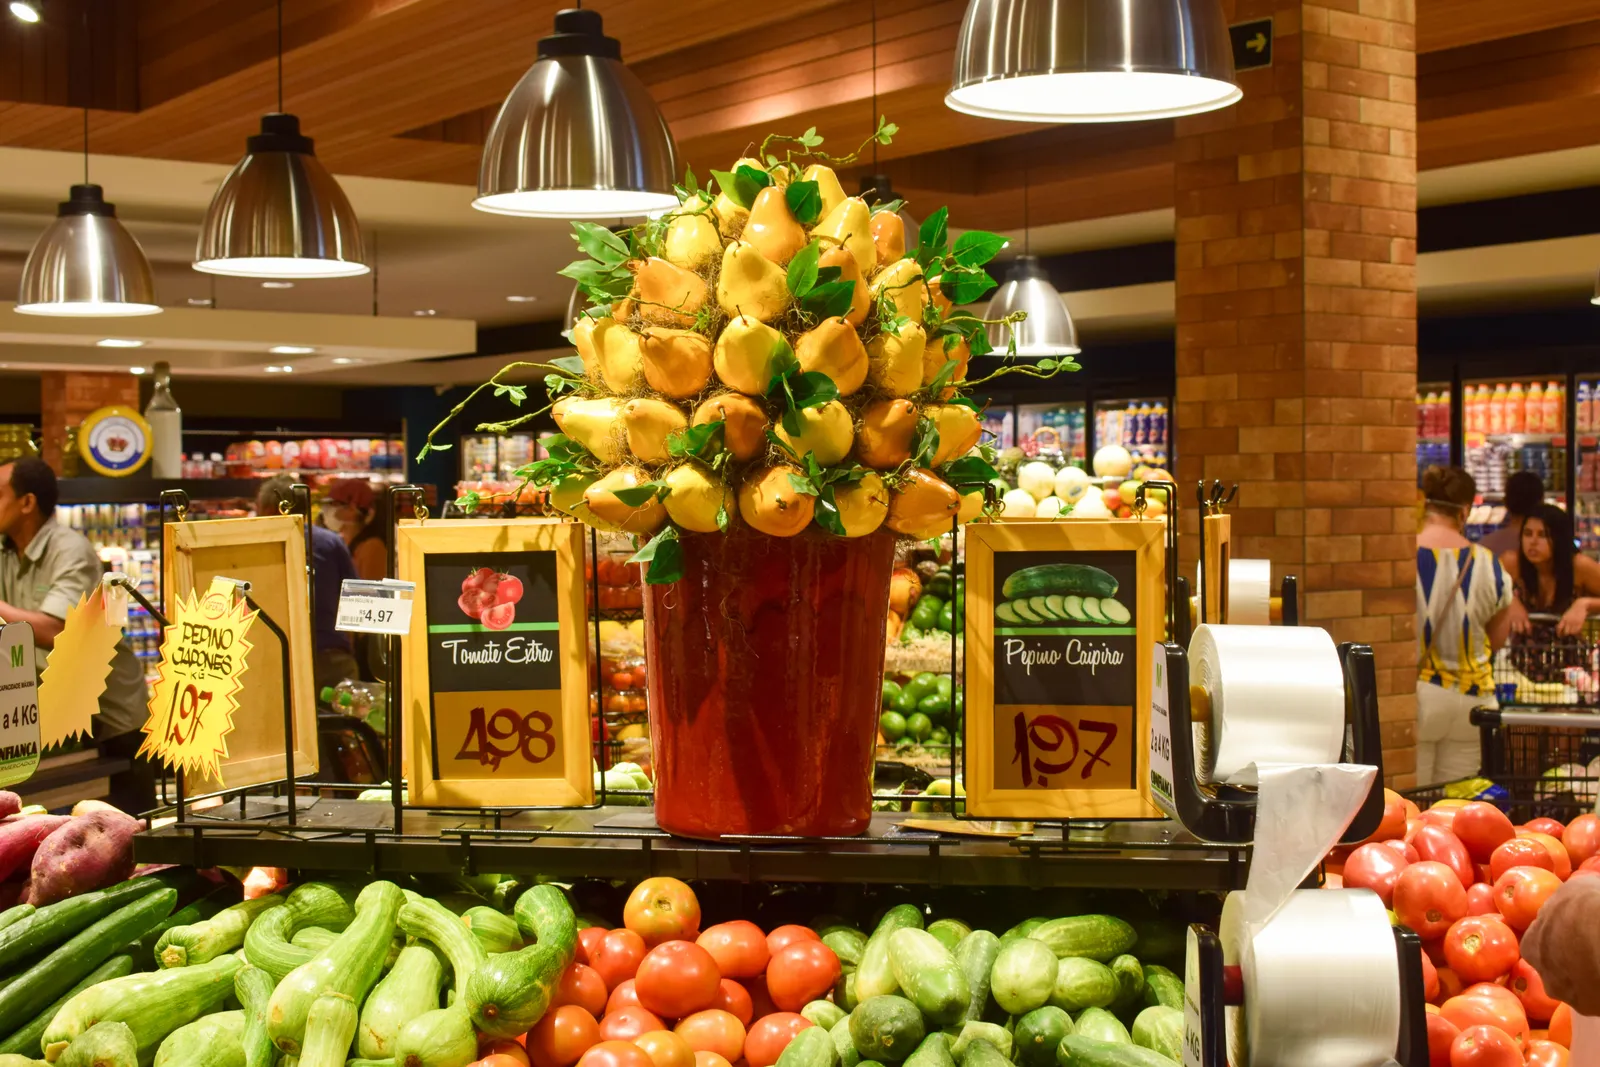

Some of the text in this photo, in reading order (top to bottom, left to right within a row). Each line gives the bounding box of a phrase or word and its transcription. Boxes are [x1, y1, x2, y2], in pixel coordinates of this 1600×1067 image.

[365, 609, 394, 624] 4,97
[182, 621, 234, 650] PEPINO
[11, 644, 24, 668] M
[441, 636, 553, 666] Tomate Extra
[1003, 638, 1124, 676] Pepino Caipira
[1155, 663, 1162, 688] M
[3, 703, 38, 729] a 4 KG
[454, 704, 556, 773] 4,98
[1158, 733, 1161, 756] 4
[1162, 735, 1170, 761] KG
[1190, 1028, 1200, 1062] KG
